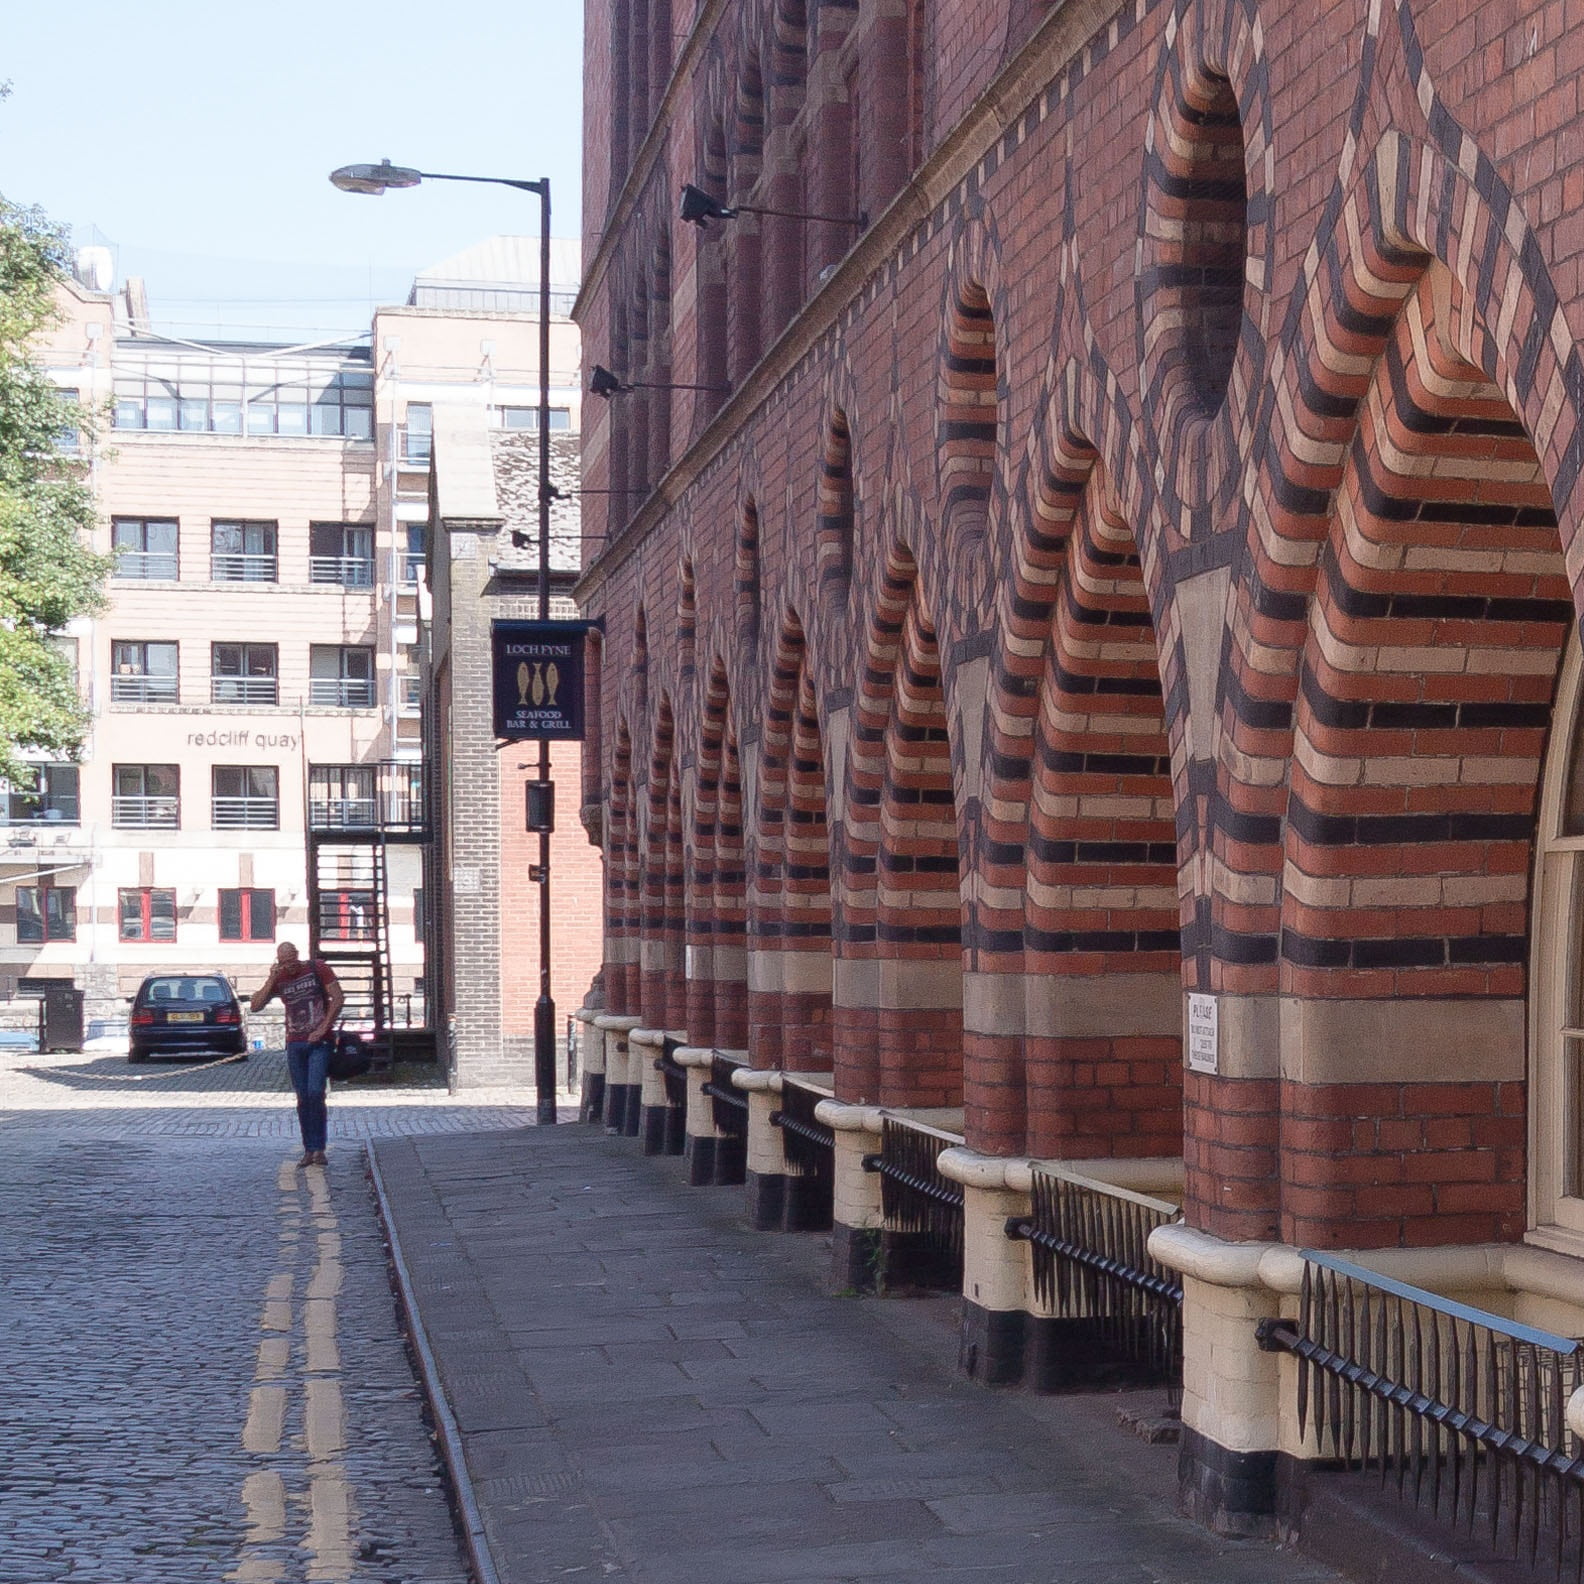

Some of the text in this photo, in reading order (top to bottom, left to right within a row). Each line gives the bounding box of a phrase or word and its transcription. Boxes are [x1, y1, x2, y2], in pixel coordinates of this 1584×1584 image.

[506, 644, 572, 656] LOCH FYNE
[515, 710, 562, 719] SEAFOOD
[506, 720, 572, 729] BAR & GRILL
[187, 730, 298, 751] redcliff quay
